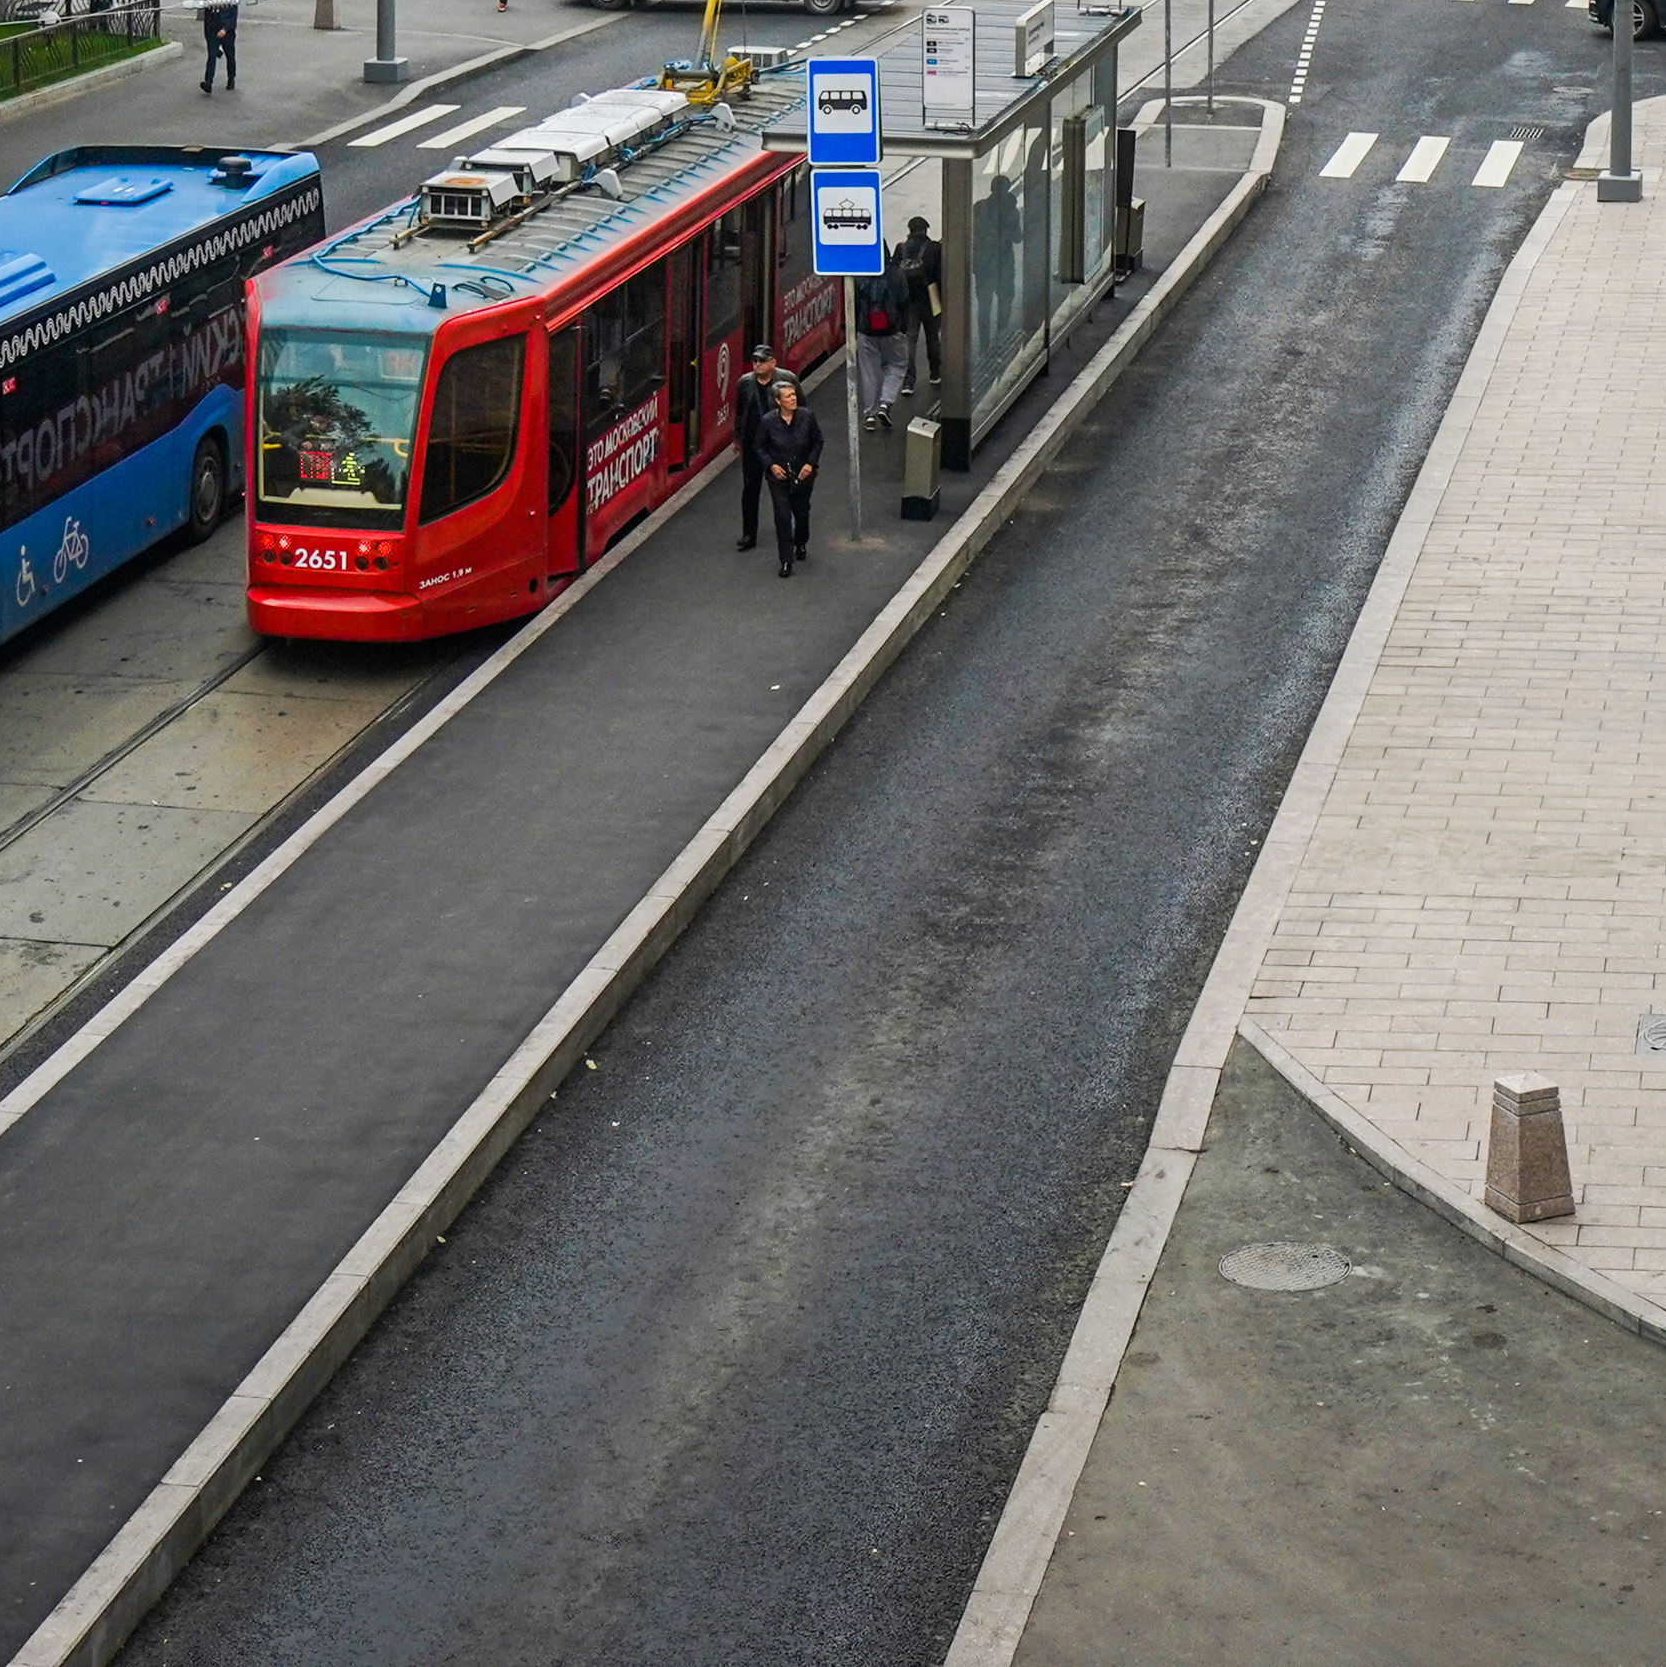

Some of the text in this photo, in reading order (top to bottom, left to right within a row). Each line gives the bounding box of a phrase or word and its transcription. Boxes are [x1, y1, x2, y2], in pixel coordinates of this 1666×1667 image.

[588, 390, 658, 471] ЭТО МОСКОВСКИЙ
[586, 427, 659, 510] ТРАНСПОРТ
[294, 547, 348, 570] 2651
[419, 572, 451, 590] ЗАНОС
[452, 567, 464, 580] 1,9
